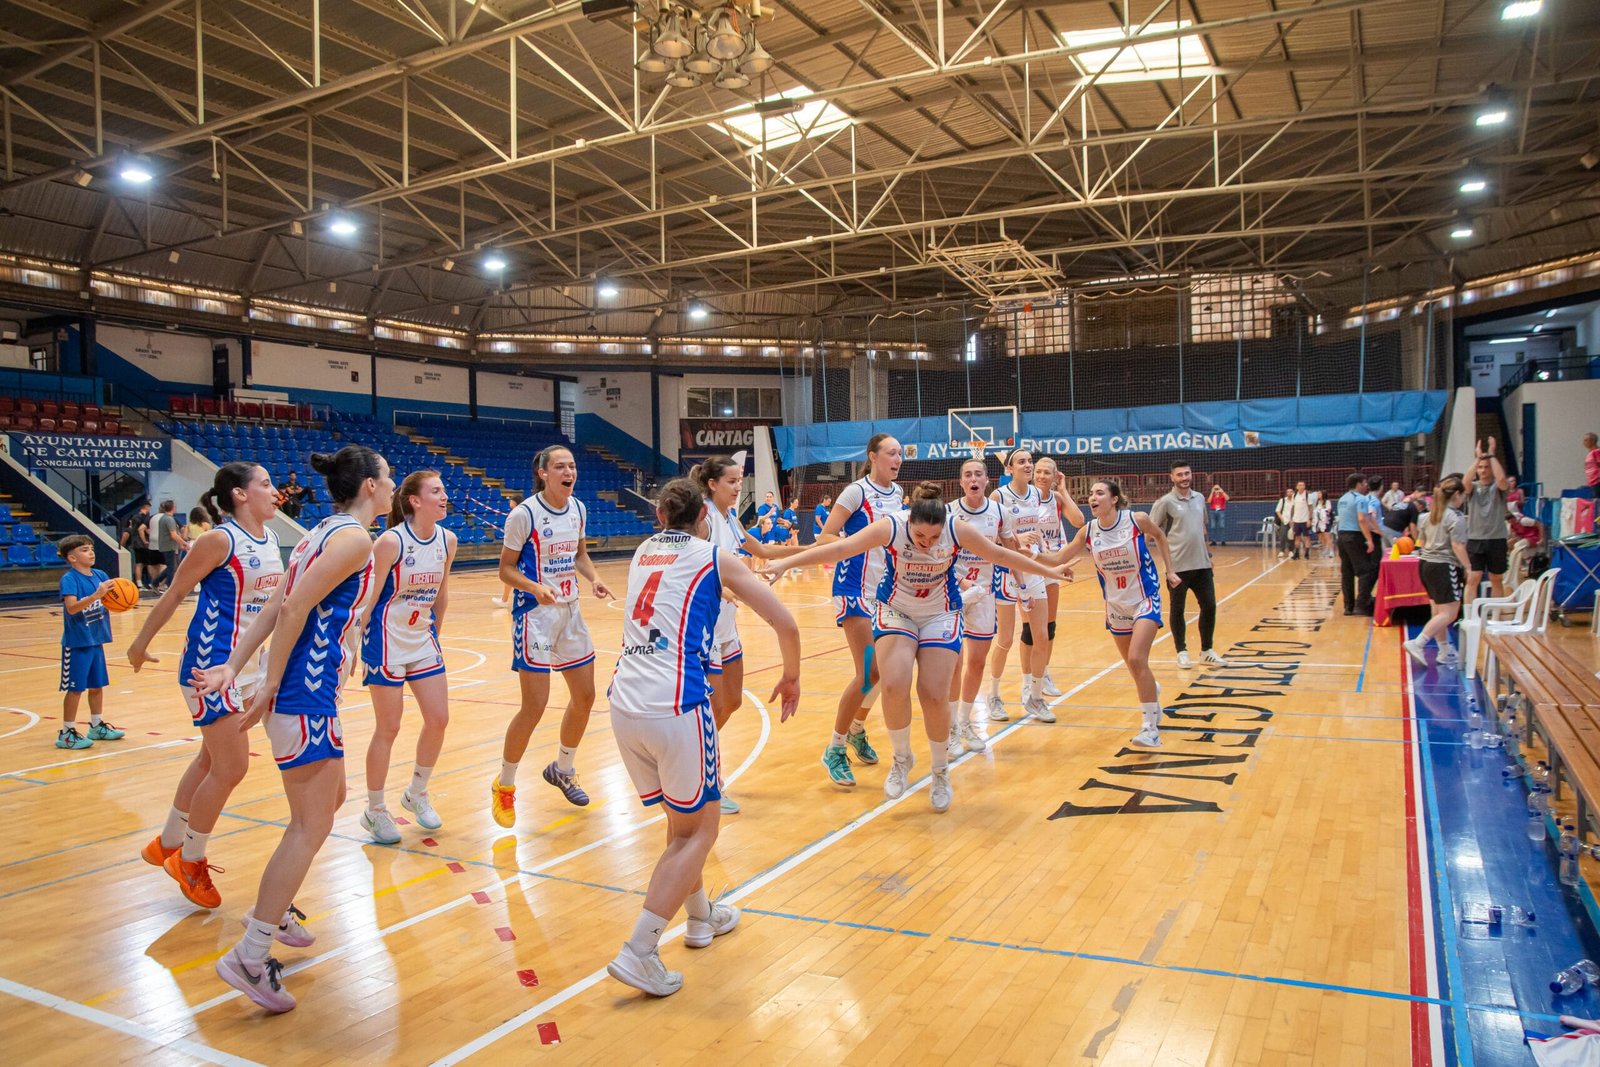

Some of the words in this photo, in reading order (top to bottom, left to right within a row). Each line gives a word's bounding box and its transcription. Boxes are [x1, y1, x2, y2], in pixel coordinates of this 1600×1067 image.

[21, 435, 163, 450] AYUNTAMIENTO
[1076, 437, 1103, 454] DE
[1108, 431, 1234, 453] CARTAGENA
[23, 446, 48, 456] DE
[56, 447, 159, 460] CARTAGENA
[965, 567, 980, 581] 23
[559, 579, 572, 597] 13
[1115, 576, 1127, 590] 18
[632, 570, 664, 627] 4
[408, 610, 420, 626] 8
